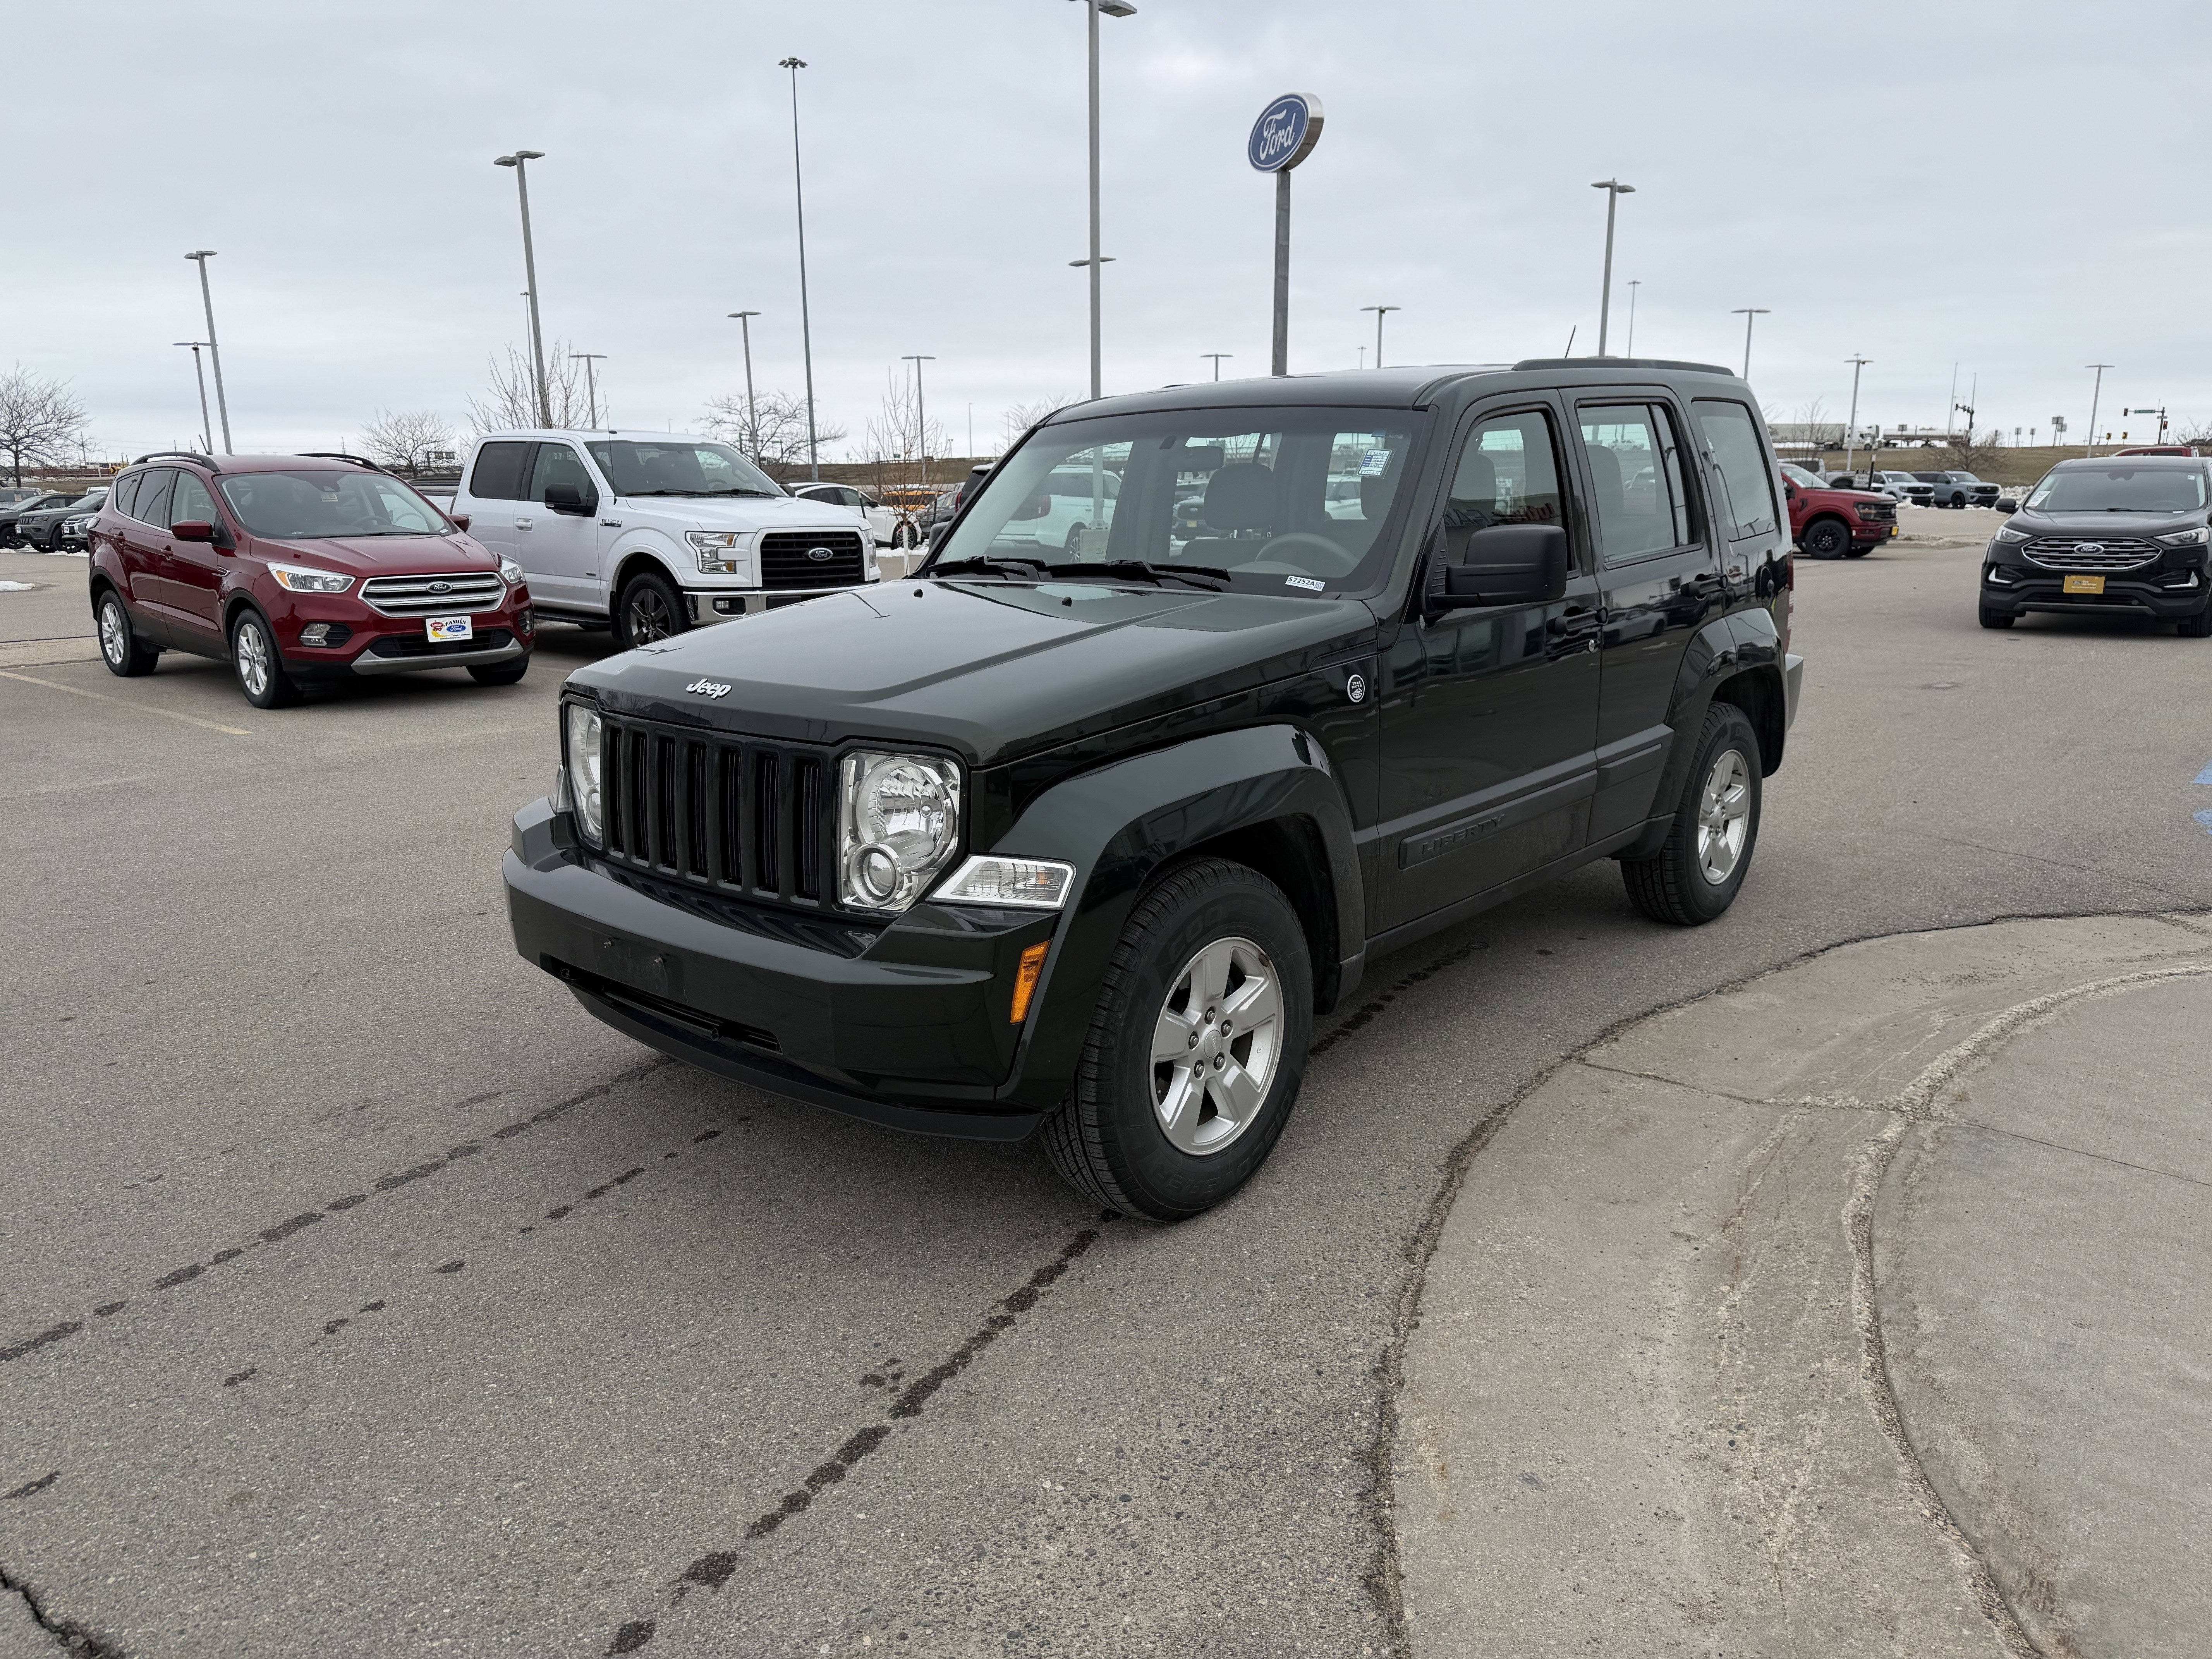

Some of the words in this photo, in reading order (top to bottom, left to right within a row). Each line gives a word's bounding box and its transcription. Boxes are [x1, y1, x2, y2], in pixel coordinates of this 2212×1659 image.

[1260, 109, 1297, 160] Ford
[1288, 577, 1314, 586] S7252A
[686, 678, 732, 699] Jeep
[1421, 814, 1505, 854] LIBERTY
